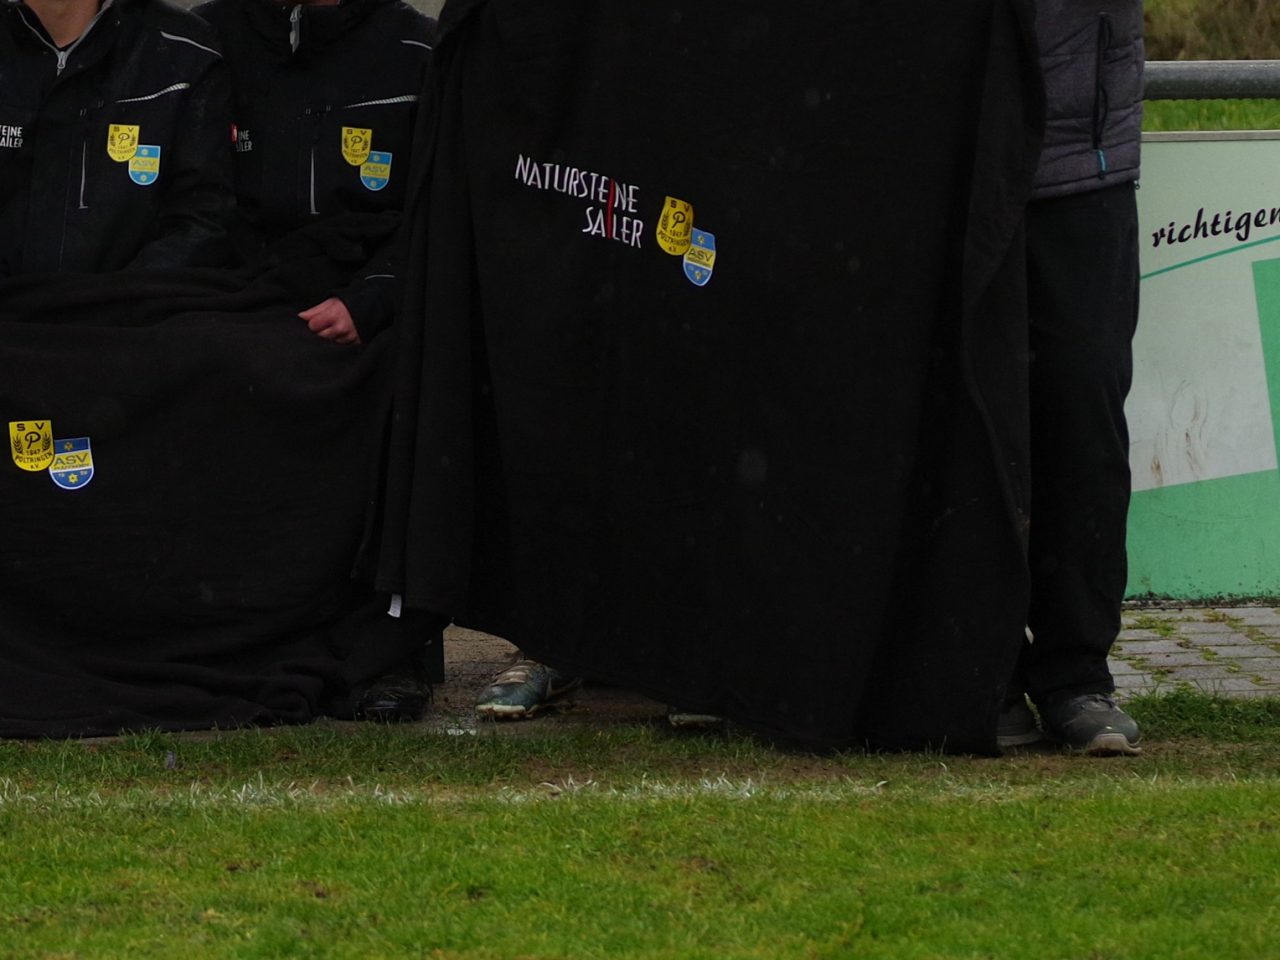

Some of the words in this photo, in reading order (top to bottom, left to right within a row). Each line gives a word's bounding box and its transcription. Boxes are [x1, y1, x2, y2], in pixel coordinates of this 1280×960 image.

[515, 153, 640, 213] NATURSTEINE
[582, 204, 643, 248] SAILER
[54, 453, 88, 466] ASV
